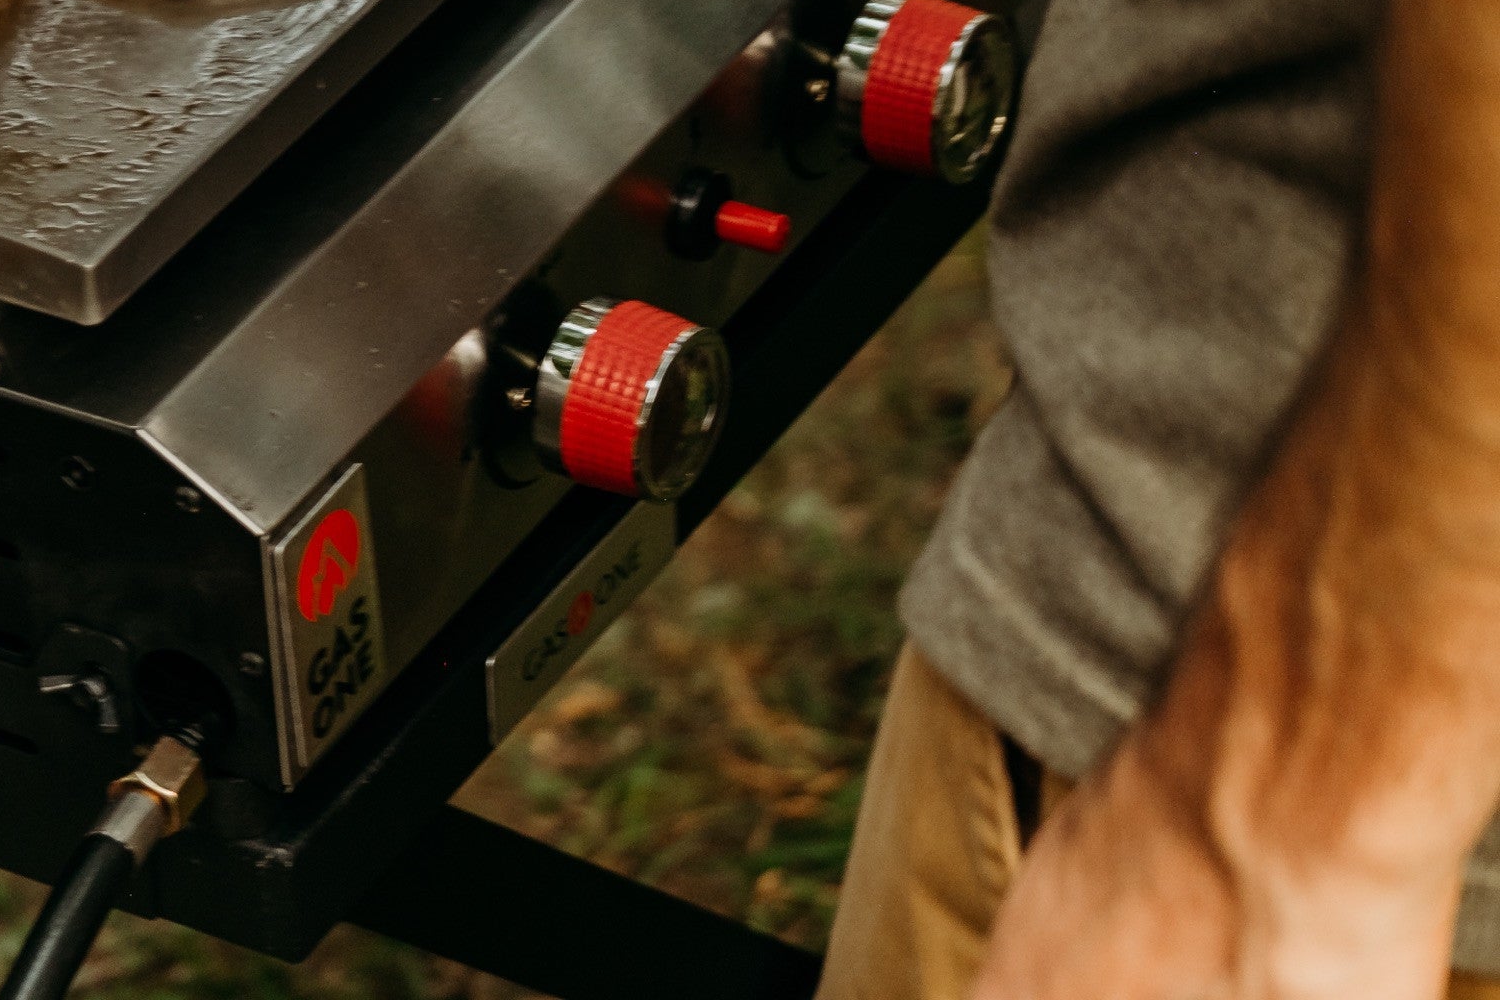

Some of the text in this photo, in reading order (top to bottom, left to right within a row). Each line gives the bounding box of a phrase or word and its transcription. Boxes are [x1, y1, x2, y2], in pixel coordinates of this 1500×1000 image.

[308, 596, 369, 695] GAS
[314, 641, 375, 739] ONE
[522, 616, 568, 681] GAS
